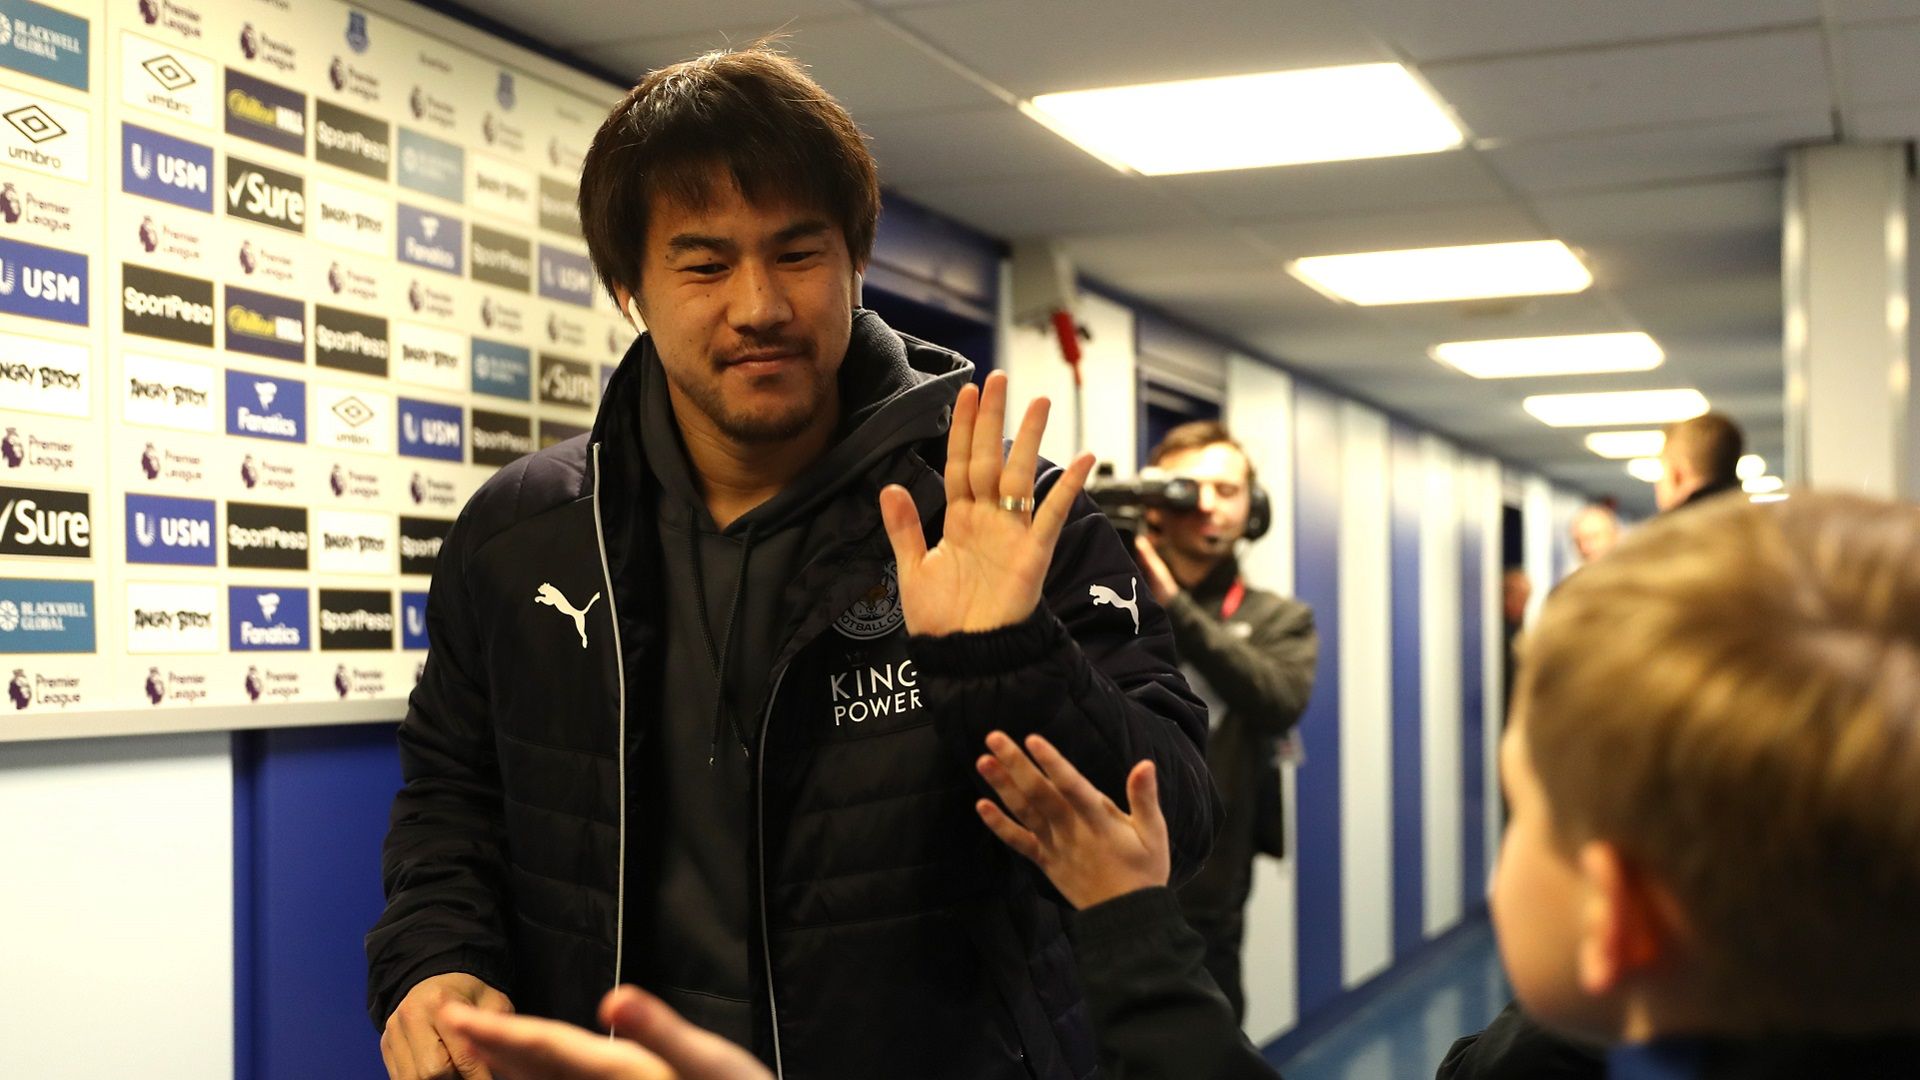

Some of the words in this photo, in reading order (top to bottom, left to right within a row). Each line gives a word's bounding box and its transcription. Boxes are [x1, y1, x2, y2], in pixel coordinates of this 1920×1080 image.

[13, 18, 81, 54] BLACKWELL
[316, 120, 388, 163] SportPesa
[8, 145, 61, 168] umbro
[157, 153, 207, 193] USM
[26, 192, 70, 214] Premier
[246, 172, 304, 225] Sure
[26, 205, 71, 231] League
[22, 266, 80, 305] USM
[124, 286, 213, 326] SportPesa
[316, 324, 388, 359] SportPesa
[0, 363, 34, 385] NGRY
[238, 406, 297, 437] Fanatics
[421, 415, 460, 447] USM
[29, 434, 72, 451] Premier
[29, 448, 74, 471] League
[15, 499, 90, 547] Sure
[160, 517, 210, 547] USM
[228, 524, 308, 550] SportPesa
[20, 601, 87, 618] BLACKWELL
[321, 608, 393, 635] SportPesa
[841, 614, 886, 632] OTBALL
[240, 621, 300, 645] Fanatics
[36, 673, 80, 688] Premier
[831, 659, 917, 701] KING
[36, 687, 81, 708] League
[834, 688, 923, 726] POWER
